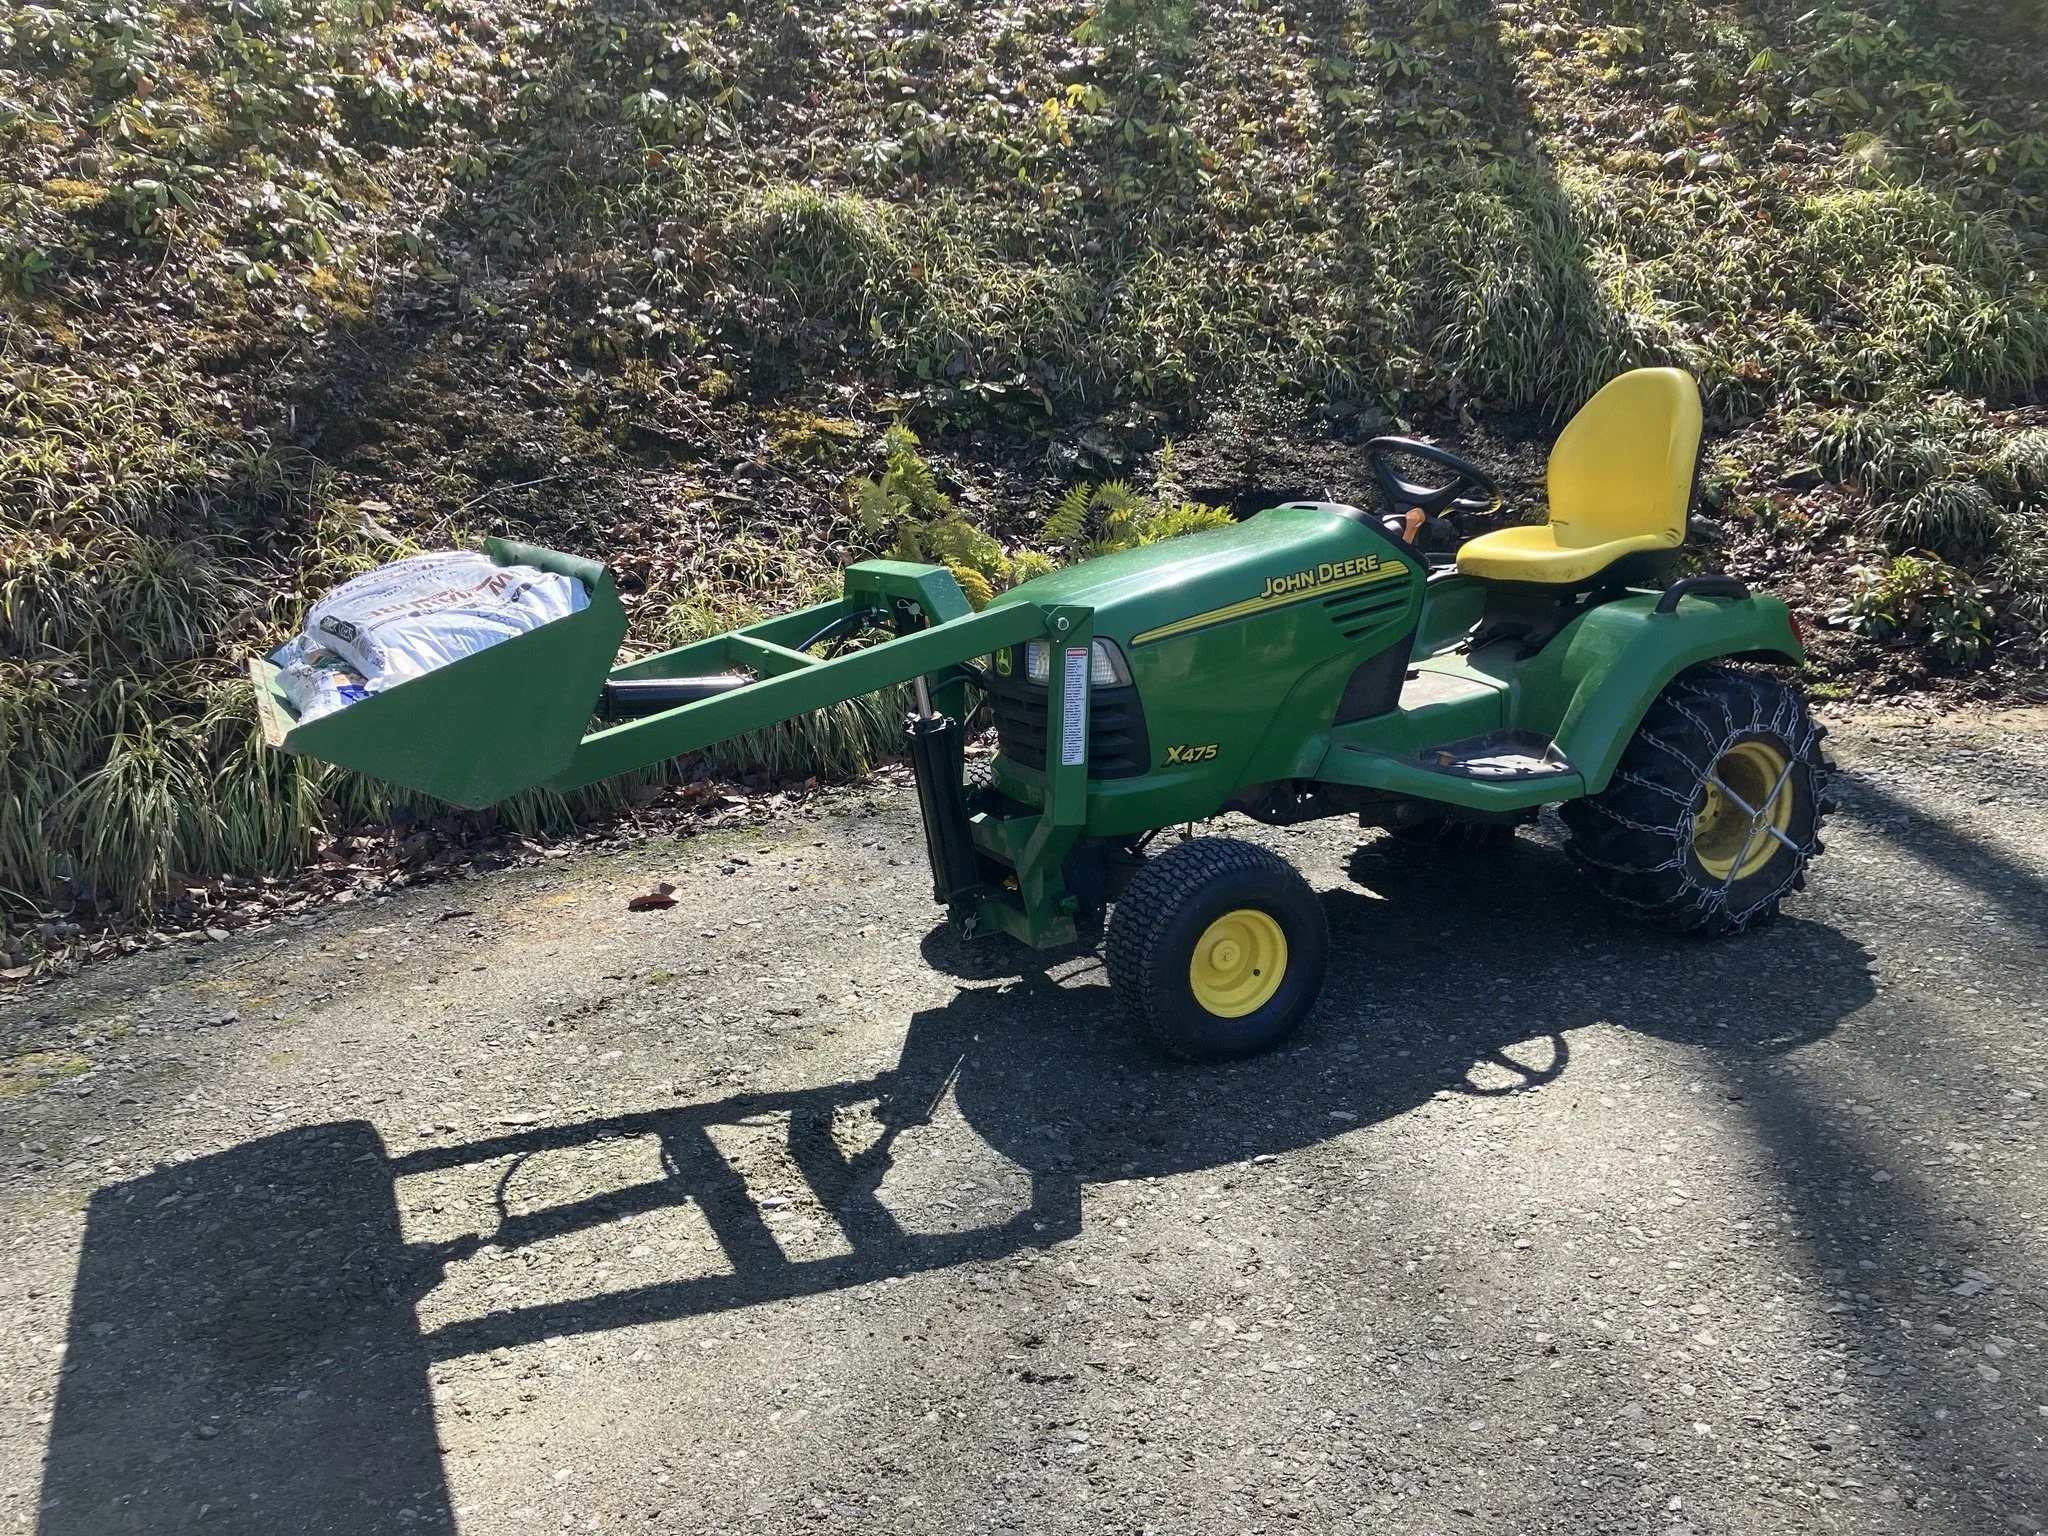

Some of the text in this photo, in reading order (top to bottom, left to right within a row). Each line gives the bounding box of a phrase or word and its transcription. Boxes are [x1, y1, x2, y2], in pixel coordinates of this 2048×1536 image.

[1260, 554, 1379, 598] JOHN DEERE
[1162, 744, 1219, 766] X475
